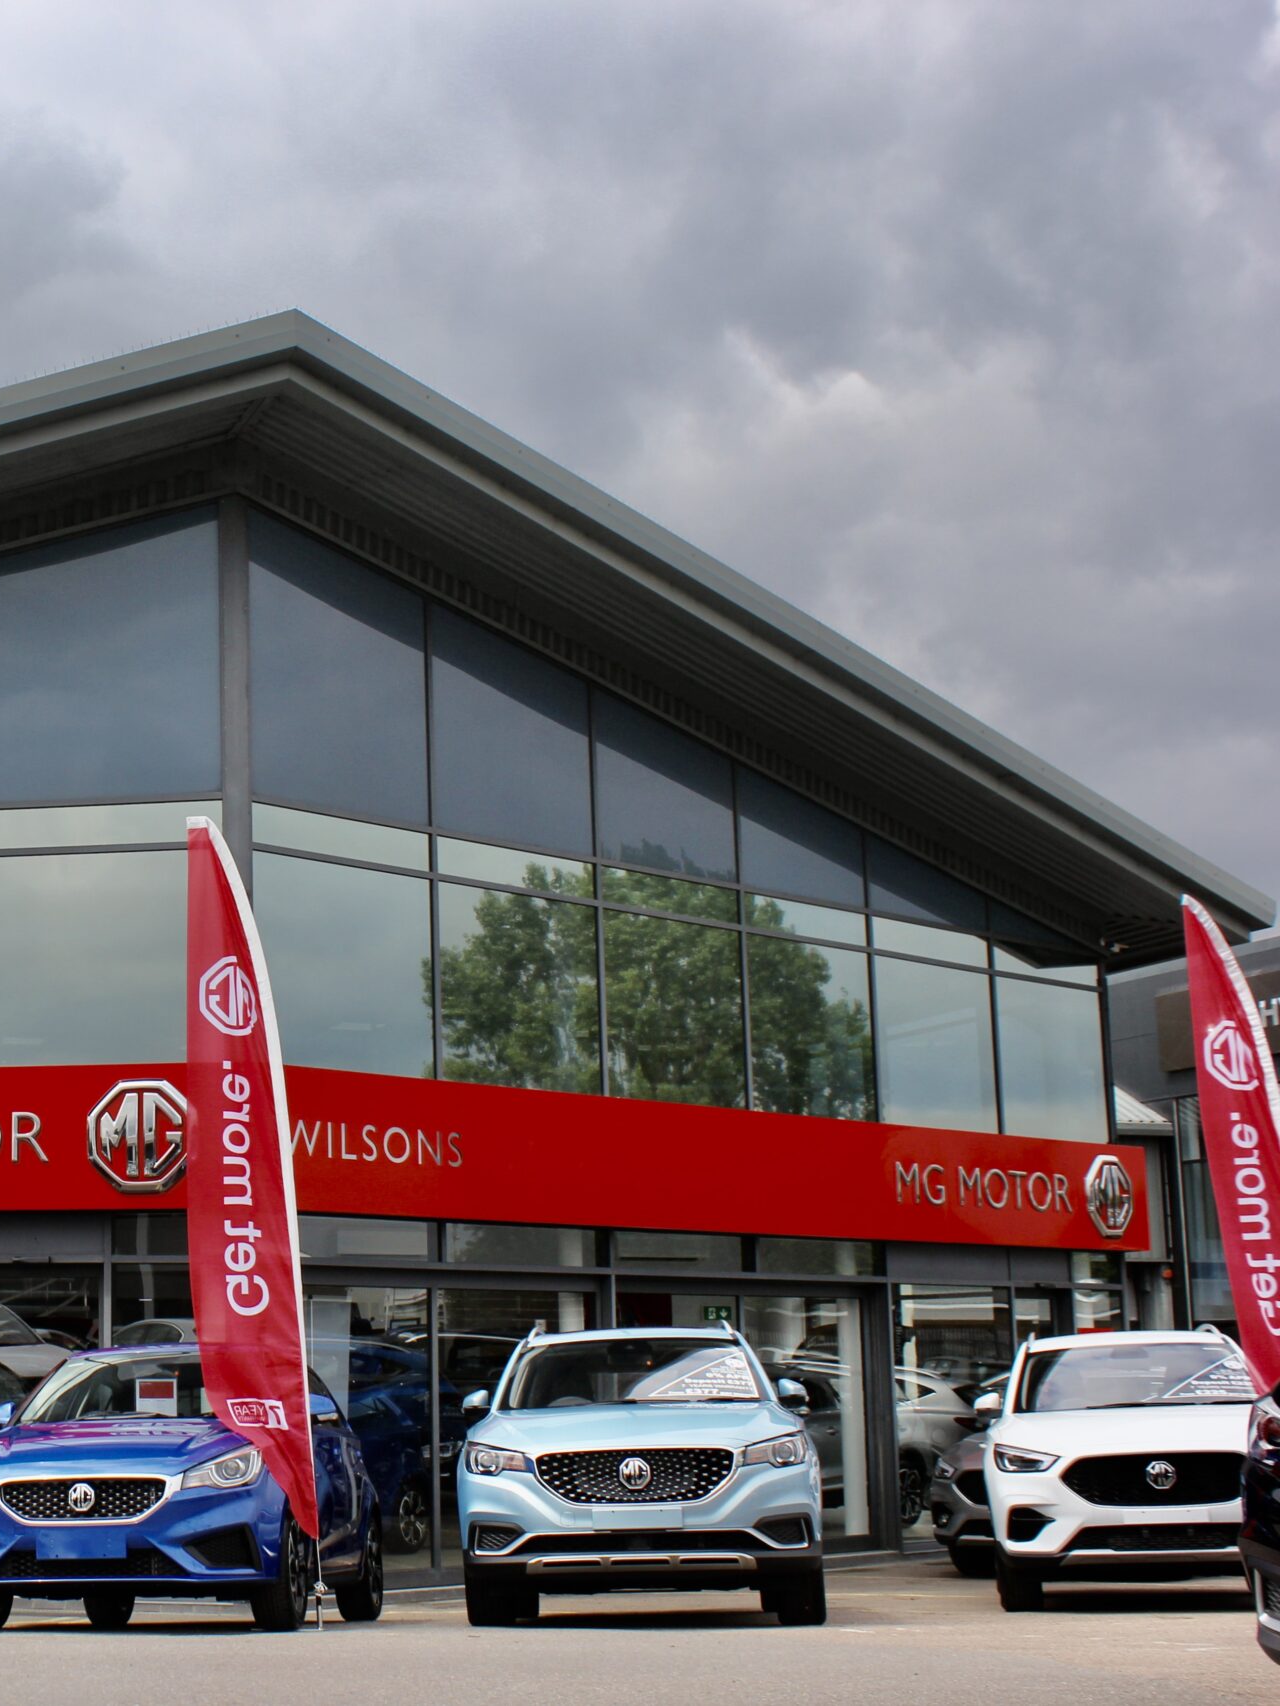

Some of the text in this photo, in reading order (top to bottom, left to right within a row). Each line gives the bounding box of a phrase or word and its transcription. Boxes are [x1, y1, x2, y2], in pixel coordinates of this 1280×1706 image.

[94, 1086, 185, 1186] MG
[291, 1119, 463, 1168] WILSONS
[895, 1161, 1073, 1213] MG MOTOR
[1087, 1160, 1132, 1232] MG
